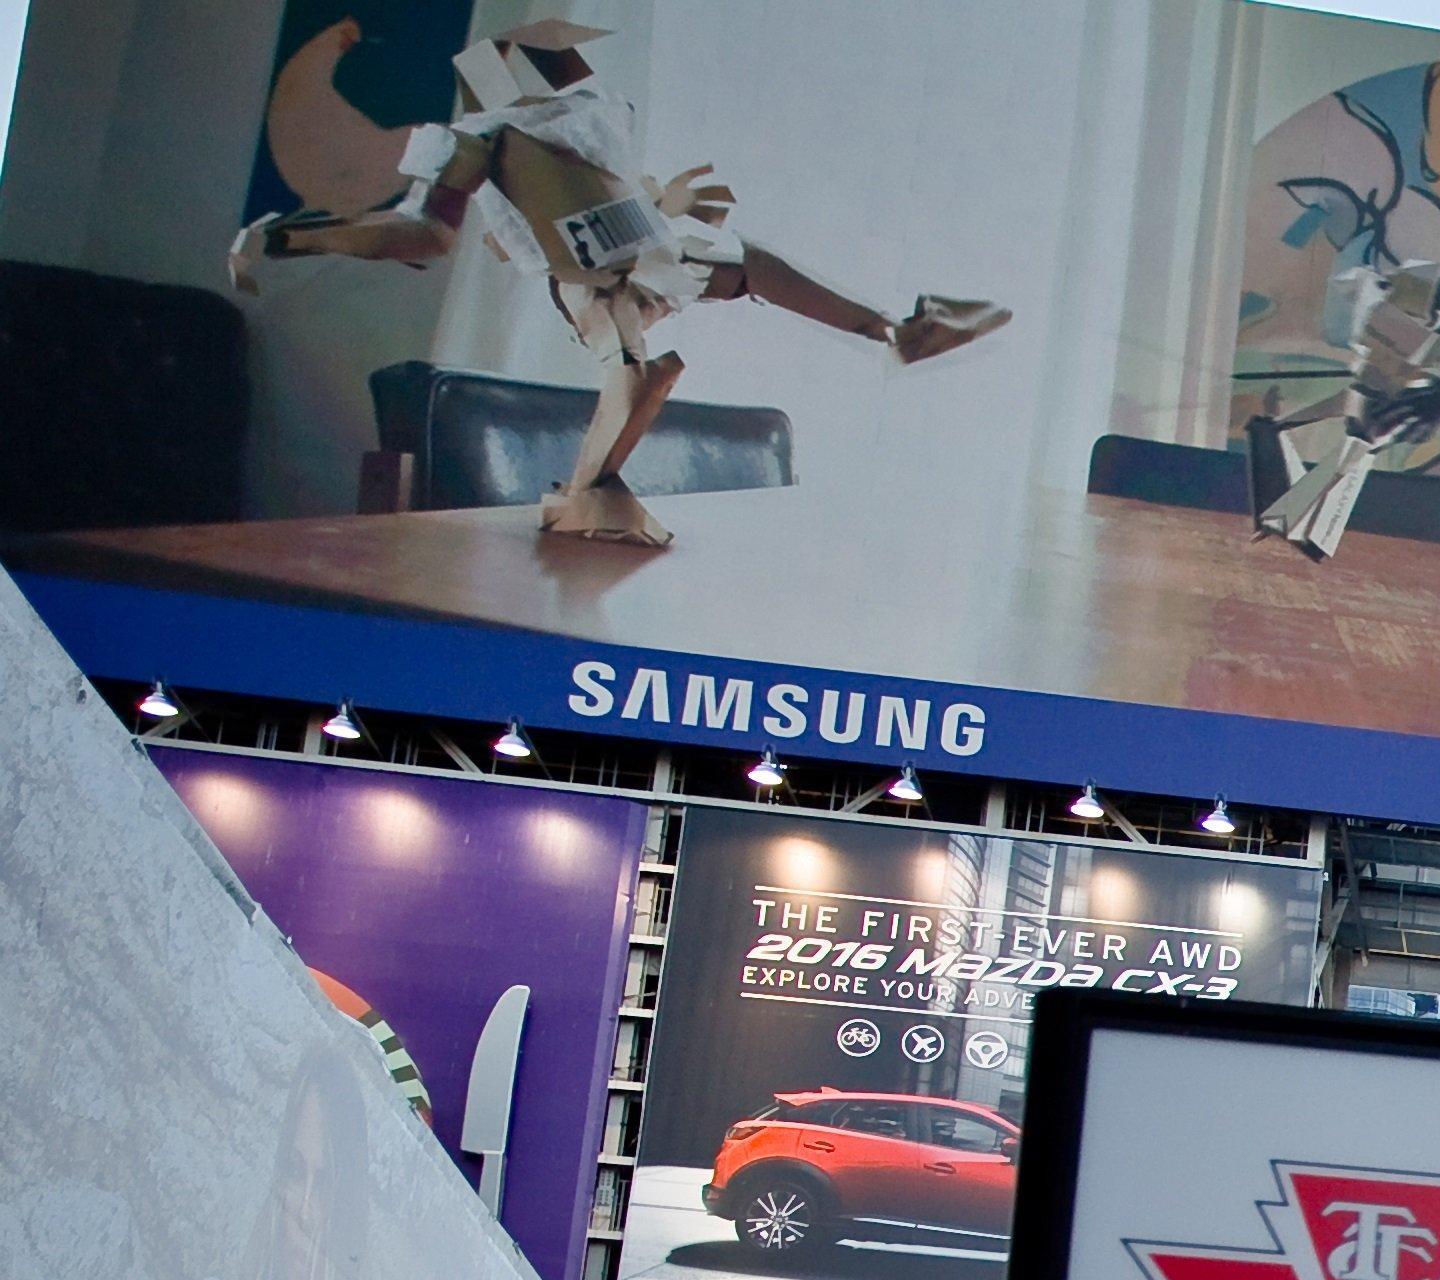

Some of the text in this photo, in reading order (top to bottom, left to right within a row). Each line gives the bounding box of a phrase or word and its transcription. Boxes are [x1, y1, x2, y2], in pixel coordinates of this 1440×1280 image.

[568, 660, 986, 756] SAMSUNG
[746, 934, 894, 965] 2016
[1112, 968, 1239, 1000] CX-3
[753, 900, 1243, 971] THE FIRST-EVER AWD
[742, 966, 1036, 1010] EXPLORE YOUR ADVE
